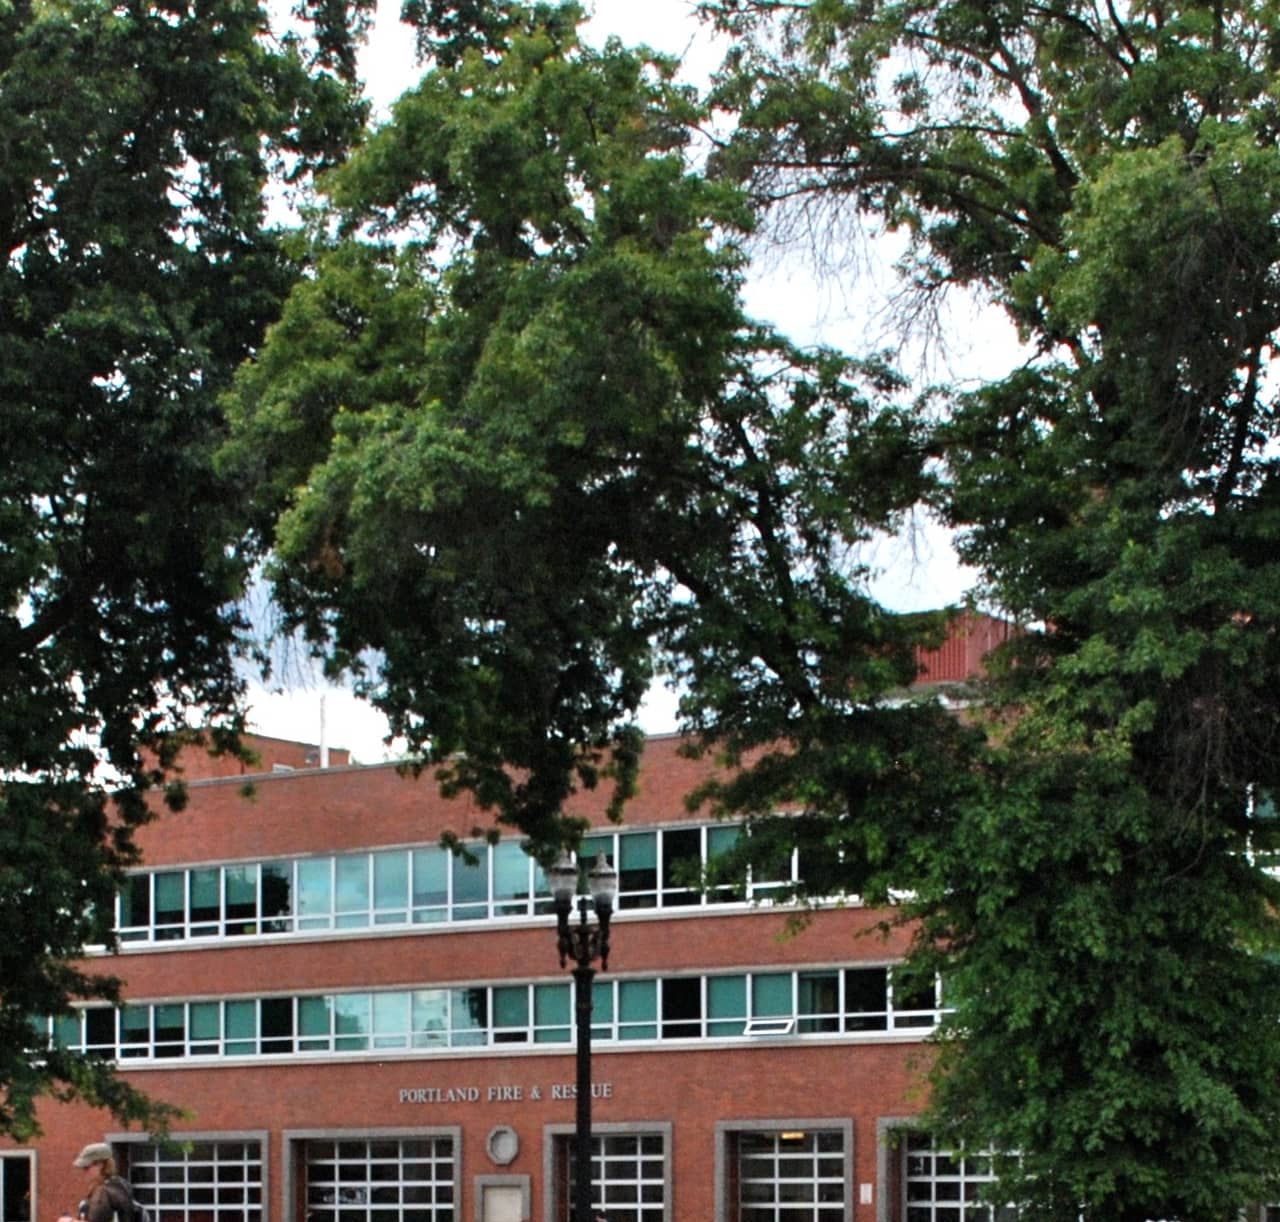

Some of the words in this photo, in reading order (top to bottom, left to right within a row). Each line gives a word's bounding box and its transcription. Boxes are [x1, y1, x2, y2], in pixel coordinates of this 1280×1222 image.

[398, 1087, 479, 1103] PORTLAND
[487, 1085, 523, 1101] FIRE
[530, 1085, 542, 1100] &
[551, 1083, 613, 1100] RESUE
